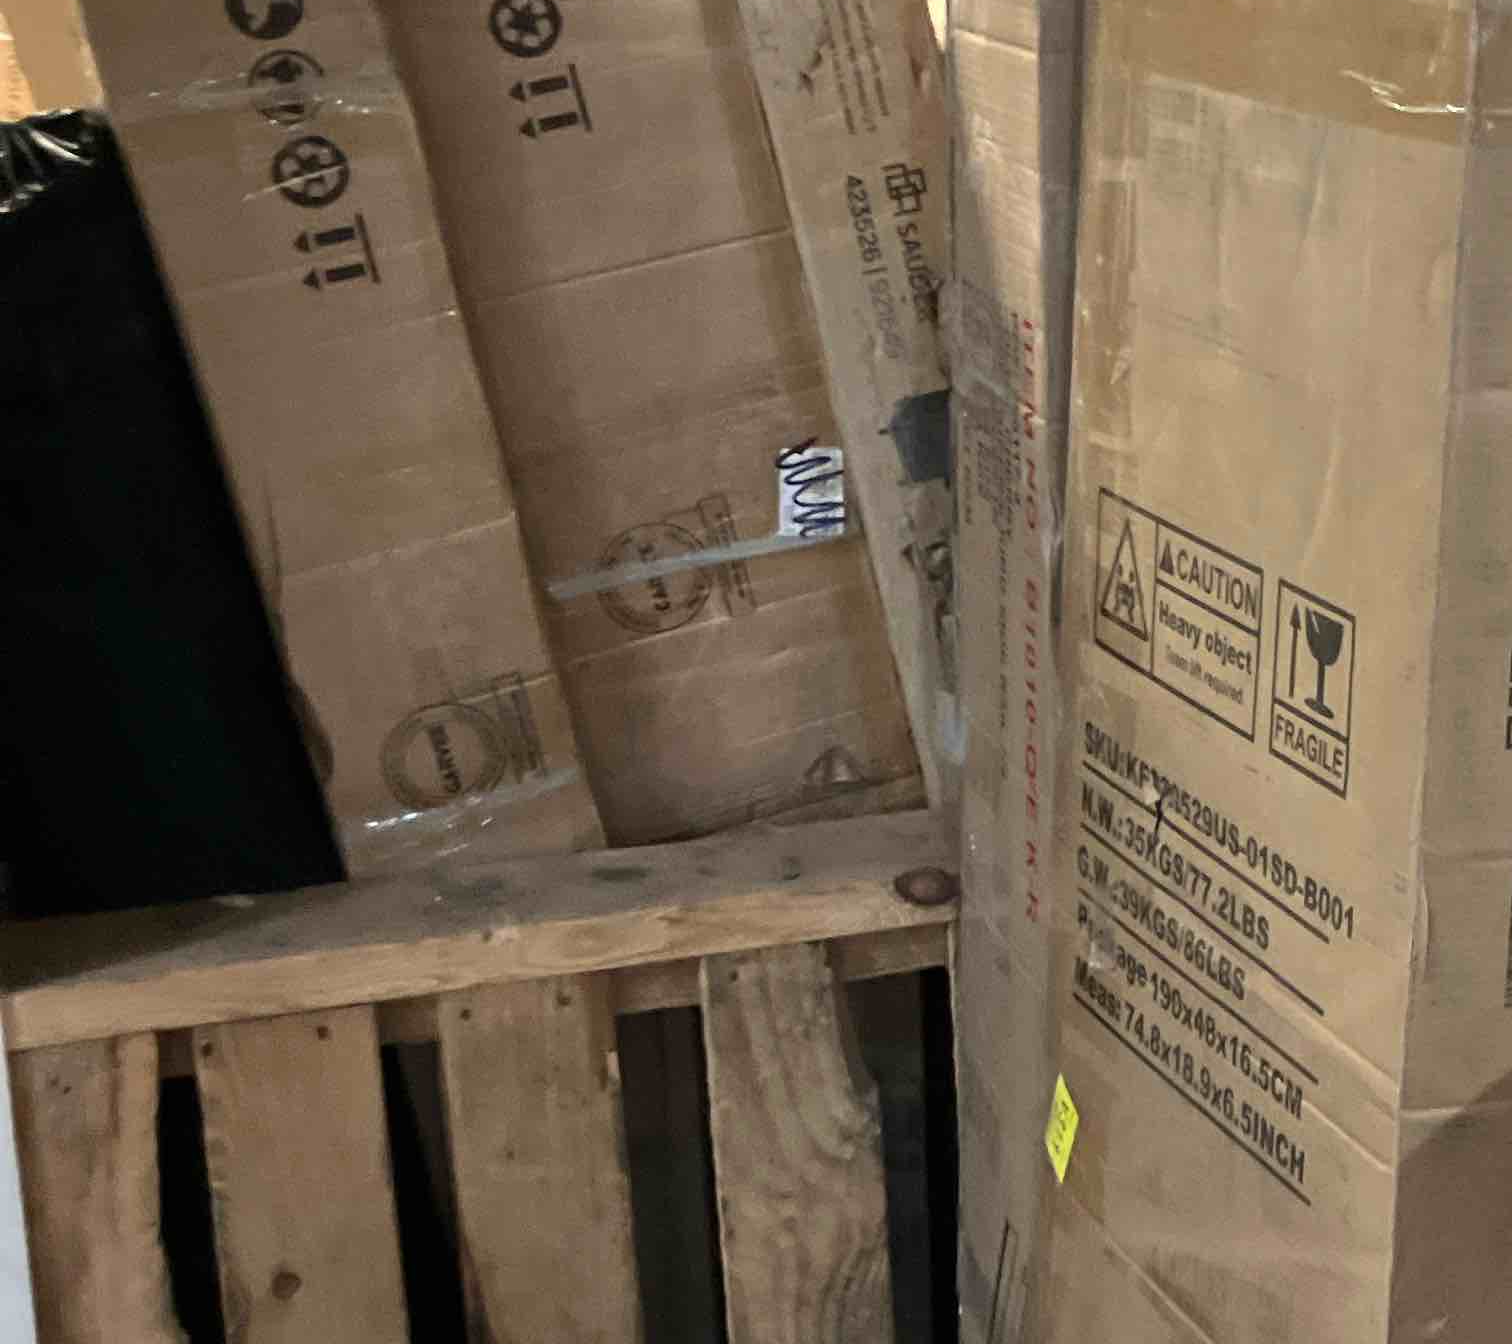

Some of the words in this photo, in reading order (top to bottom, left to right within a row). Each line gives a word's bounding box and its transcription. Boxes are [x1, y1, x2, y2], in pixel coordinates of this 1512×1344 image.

[1177, 547, 1258, 619] CAUTION
[1159, 599, 1201, 651] Heavy
[1205, 634, 1253, 676] object
[1275, 713, 1345, 779] FRAGILE
